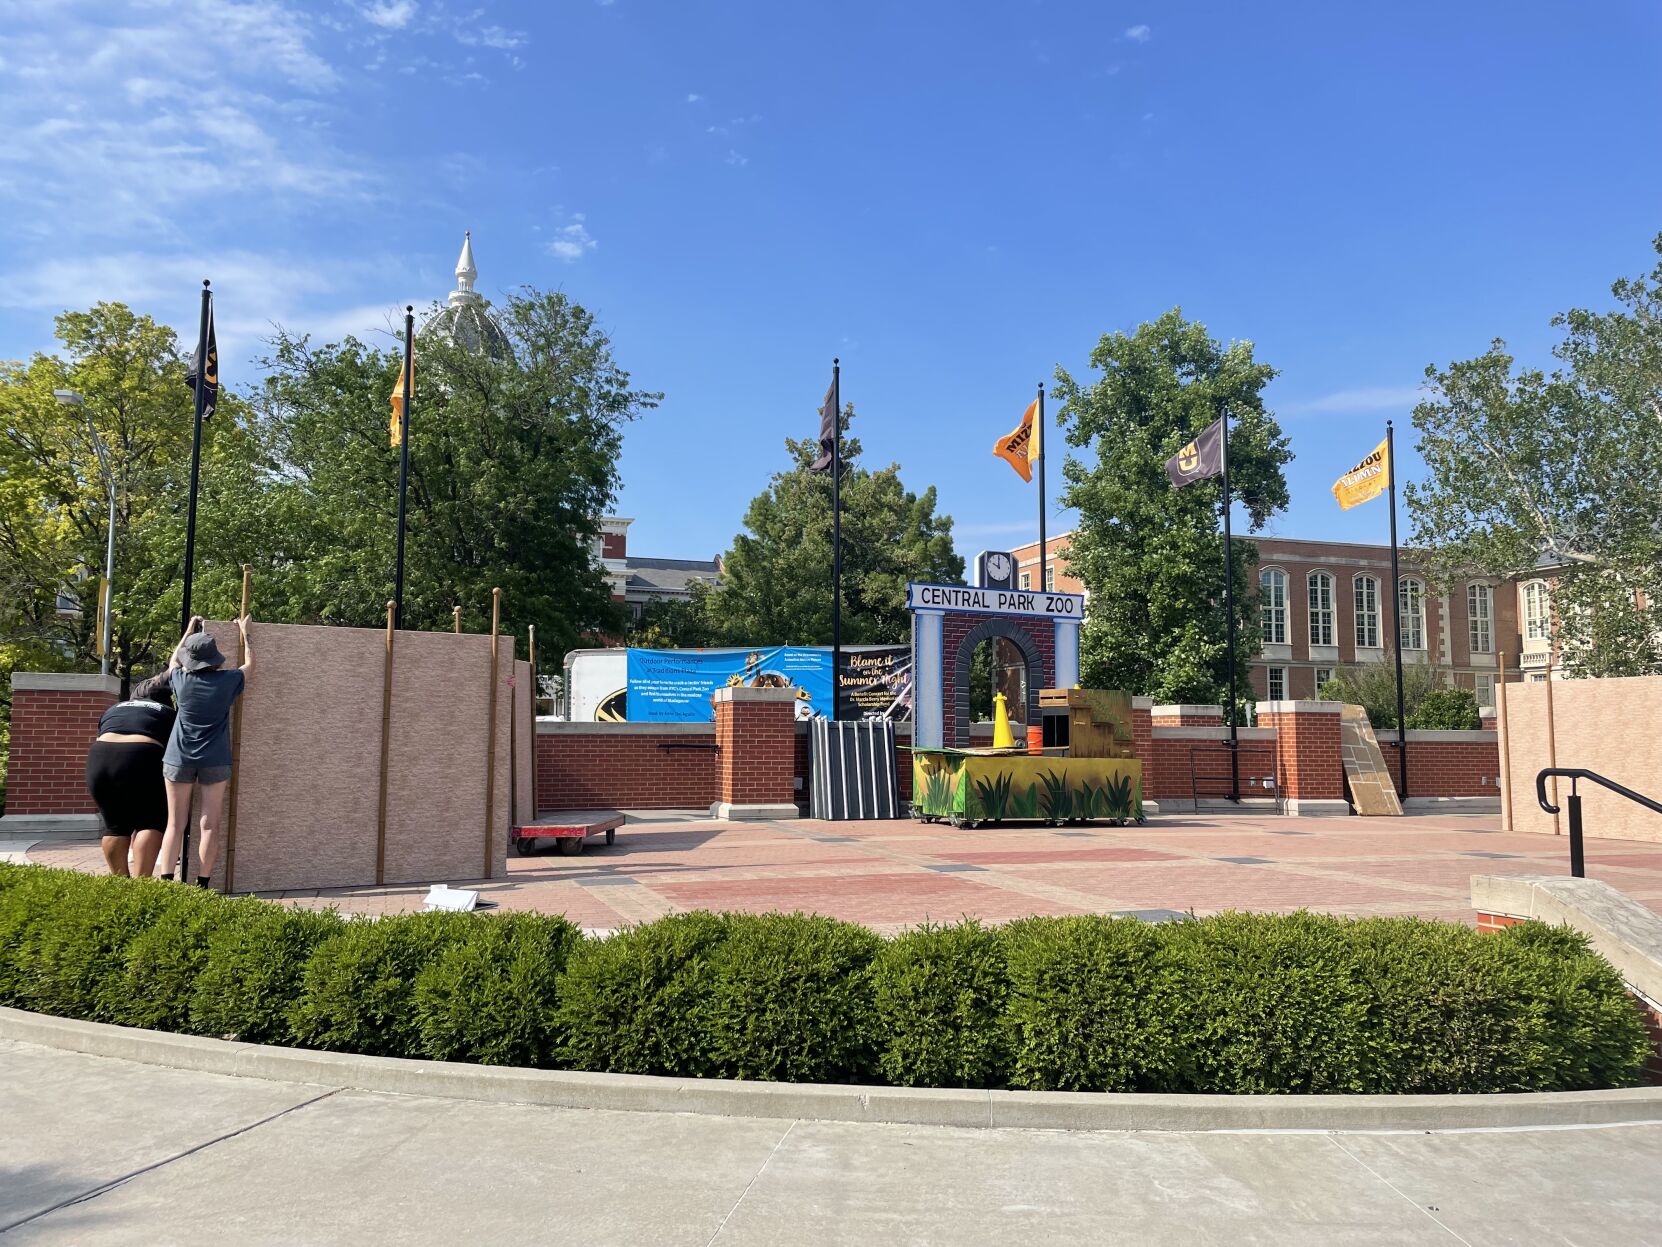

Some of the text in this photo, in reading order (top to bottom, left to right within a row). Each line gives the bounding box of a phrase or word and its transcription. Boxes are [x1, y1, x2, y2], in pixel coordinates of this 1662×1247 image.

[921, 587, 1074, 614] CENTRAL PARK ZOO
[640, 657, 704, 665] Outdoor Performances
[850, 654, 894, 668] Blame it
[871, 666, 882, 675] the
[839, 674, 879, 687] Summer
